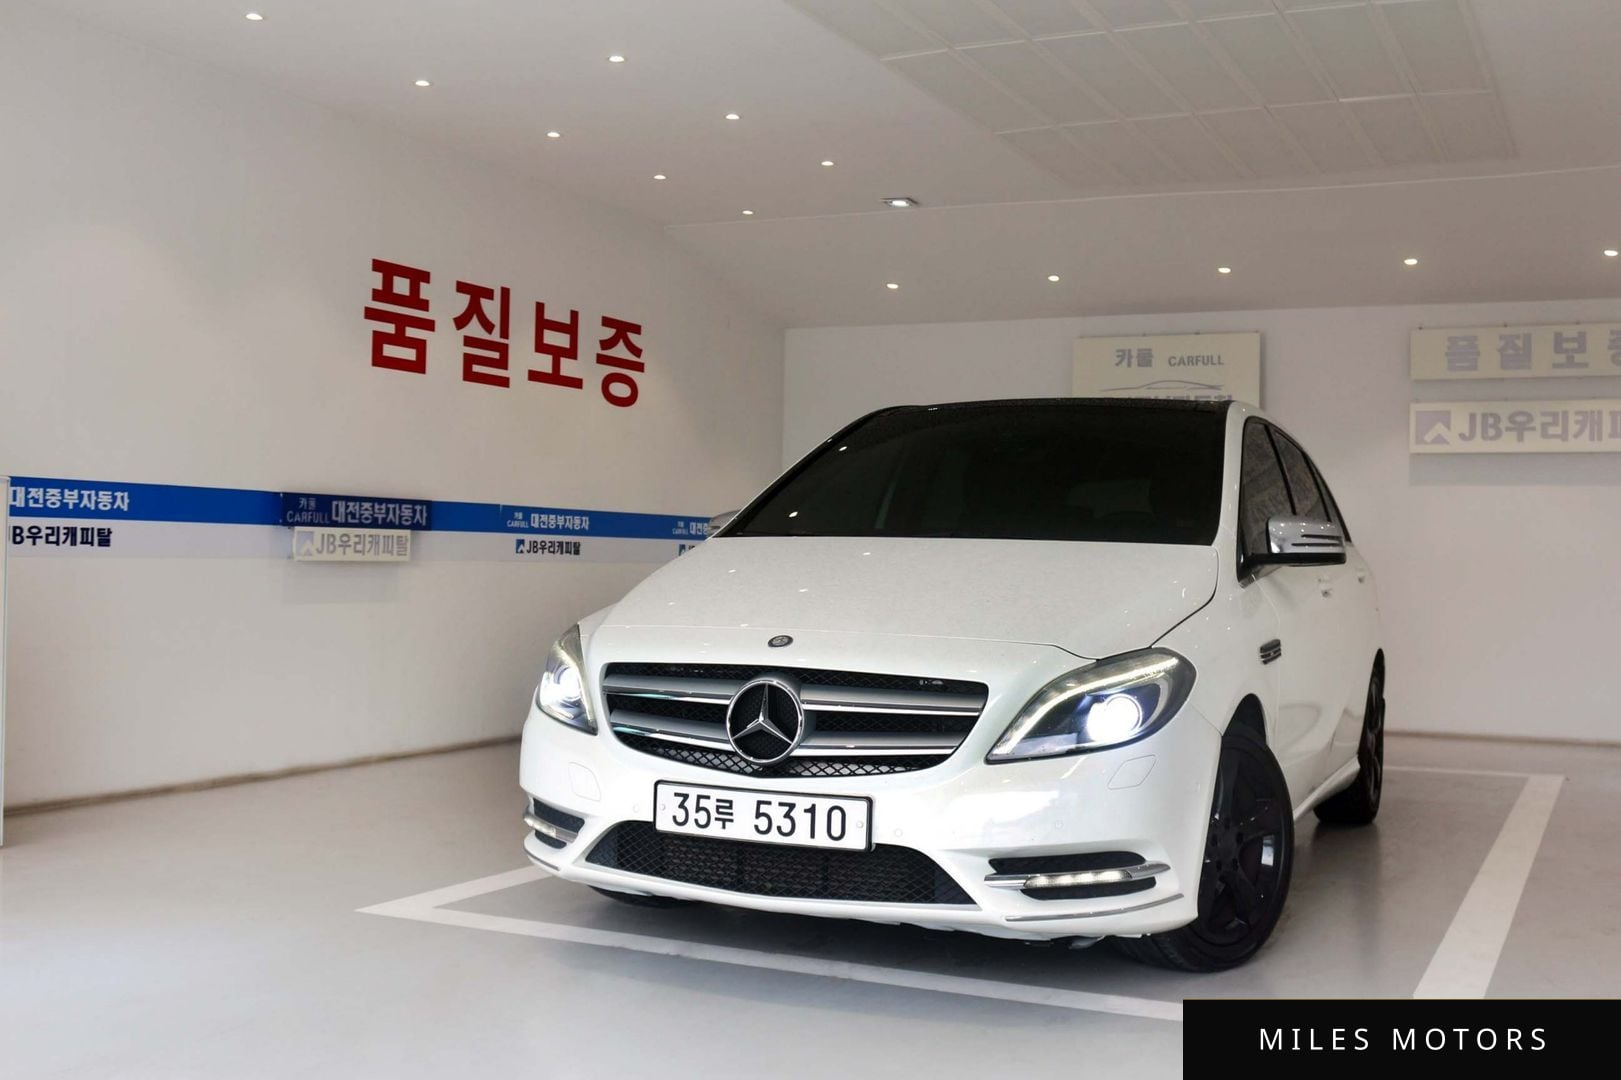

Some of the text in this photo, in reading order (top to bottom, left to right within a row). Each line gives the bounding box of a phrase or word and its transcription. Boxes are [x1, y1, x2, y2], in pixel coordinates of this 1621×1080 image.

[364, 258, 645, 408] 품질보증
[1168, 354, 1225, 367] CARFULL
[8, 486, 130, 512] 대전중부자동차
[286, 510, 331, 524] CARFULL
[331, 500, 428, 526] 대전중부자동차
[8, 525, 113, 547] B우리캐피탈
[315, 533, 409, 557] JB우리캐피탈
[672, 792, 847, 842] 35루 5310
